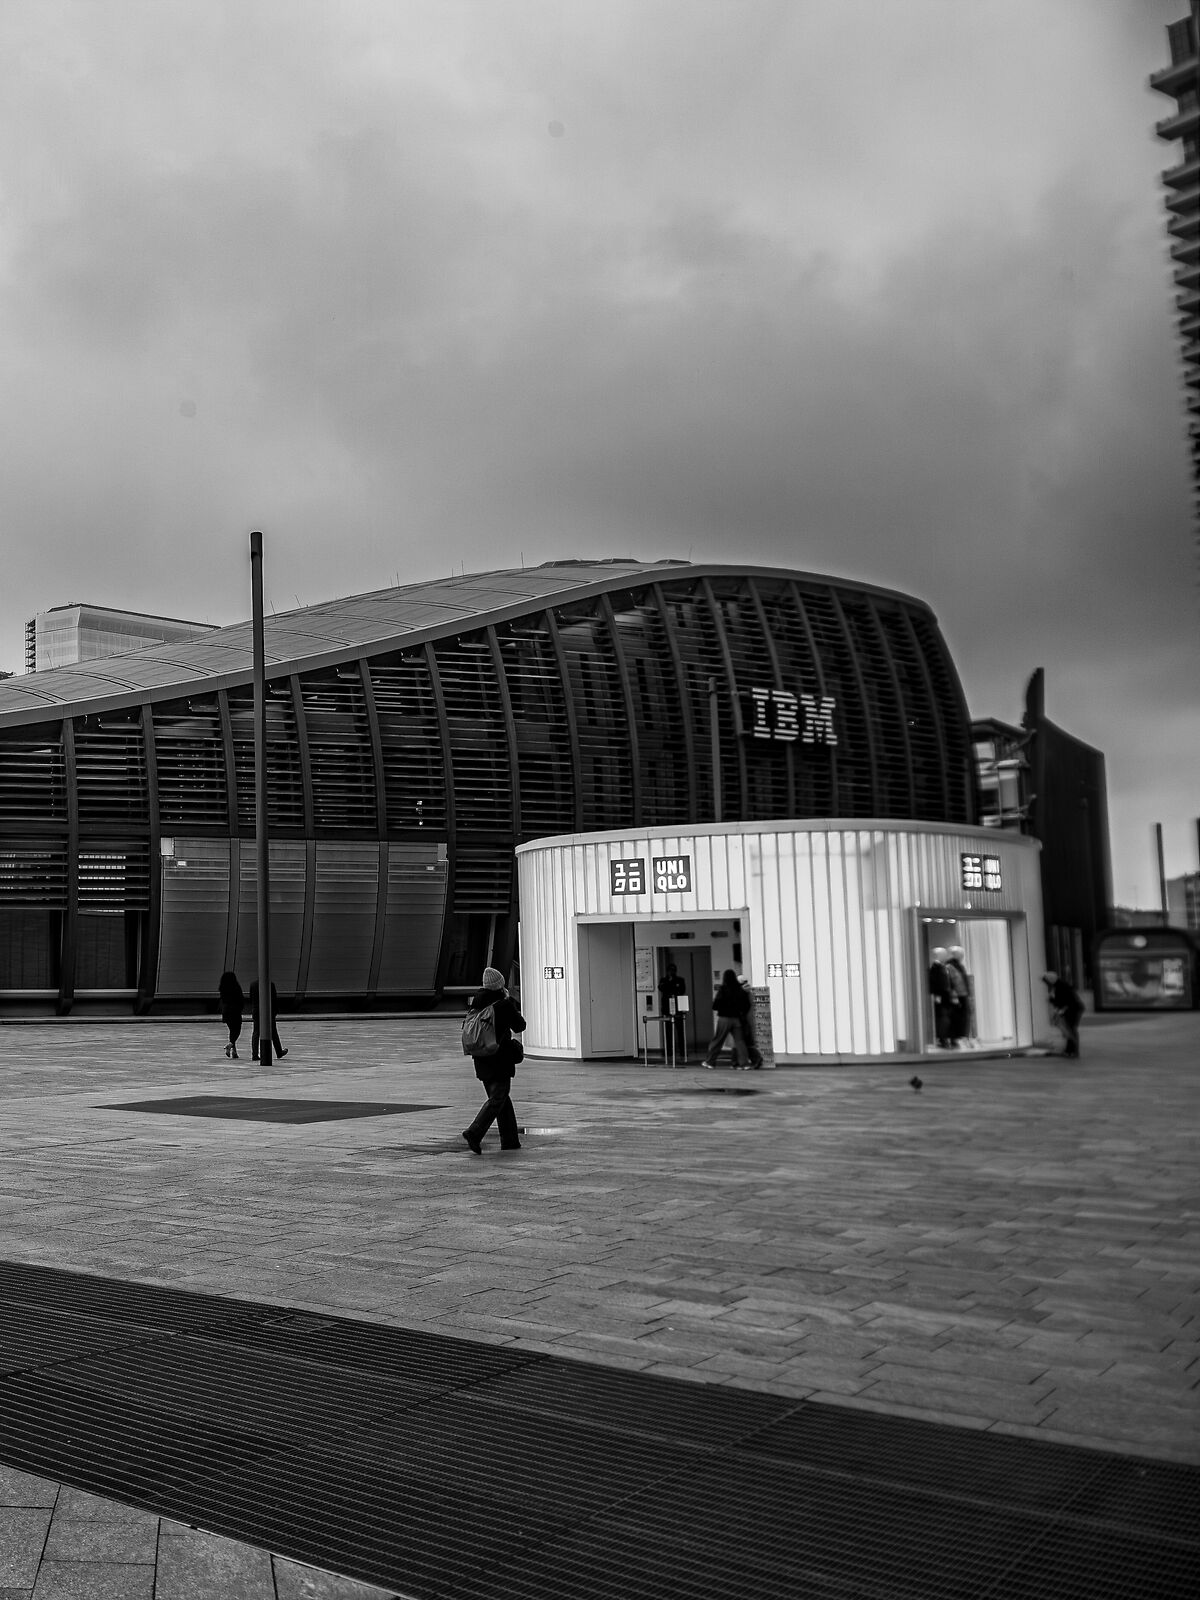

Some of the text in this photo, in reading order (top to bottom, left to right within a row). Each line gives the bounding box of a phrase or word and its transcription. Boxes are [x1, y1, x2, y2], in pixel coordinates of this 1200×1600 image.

[752, 688, 838, 745] IBM
[656, 859, 684, 875] UNI
[657, 874, 687, 892] QLO
